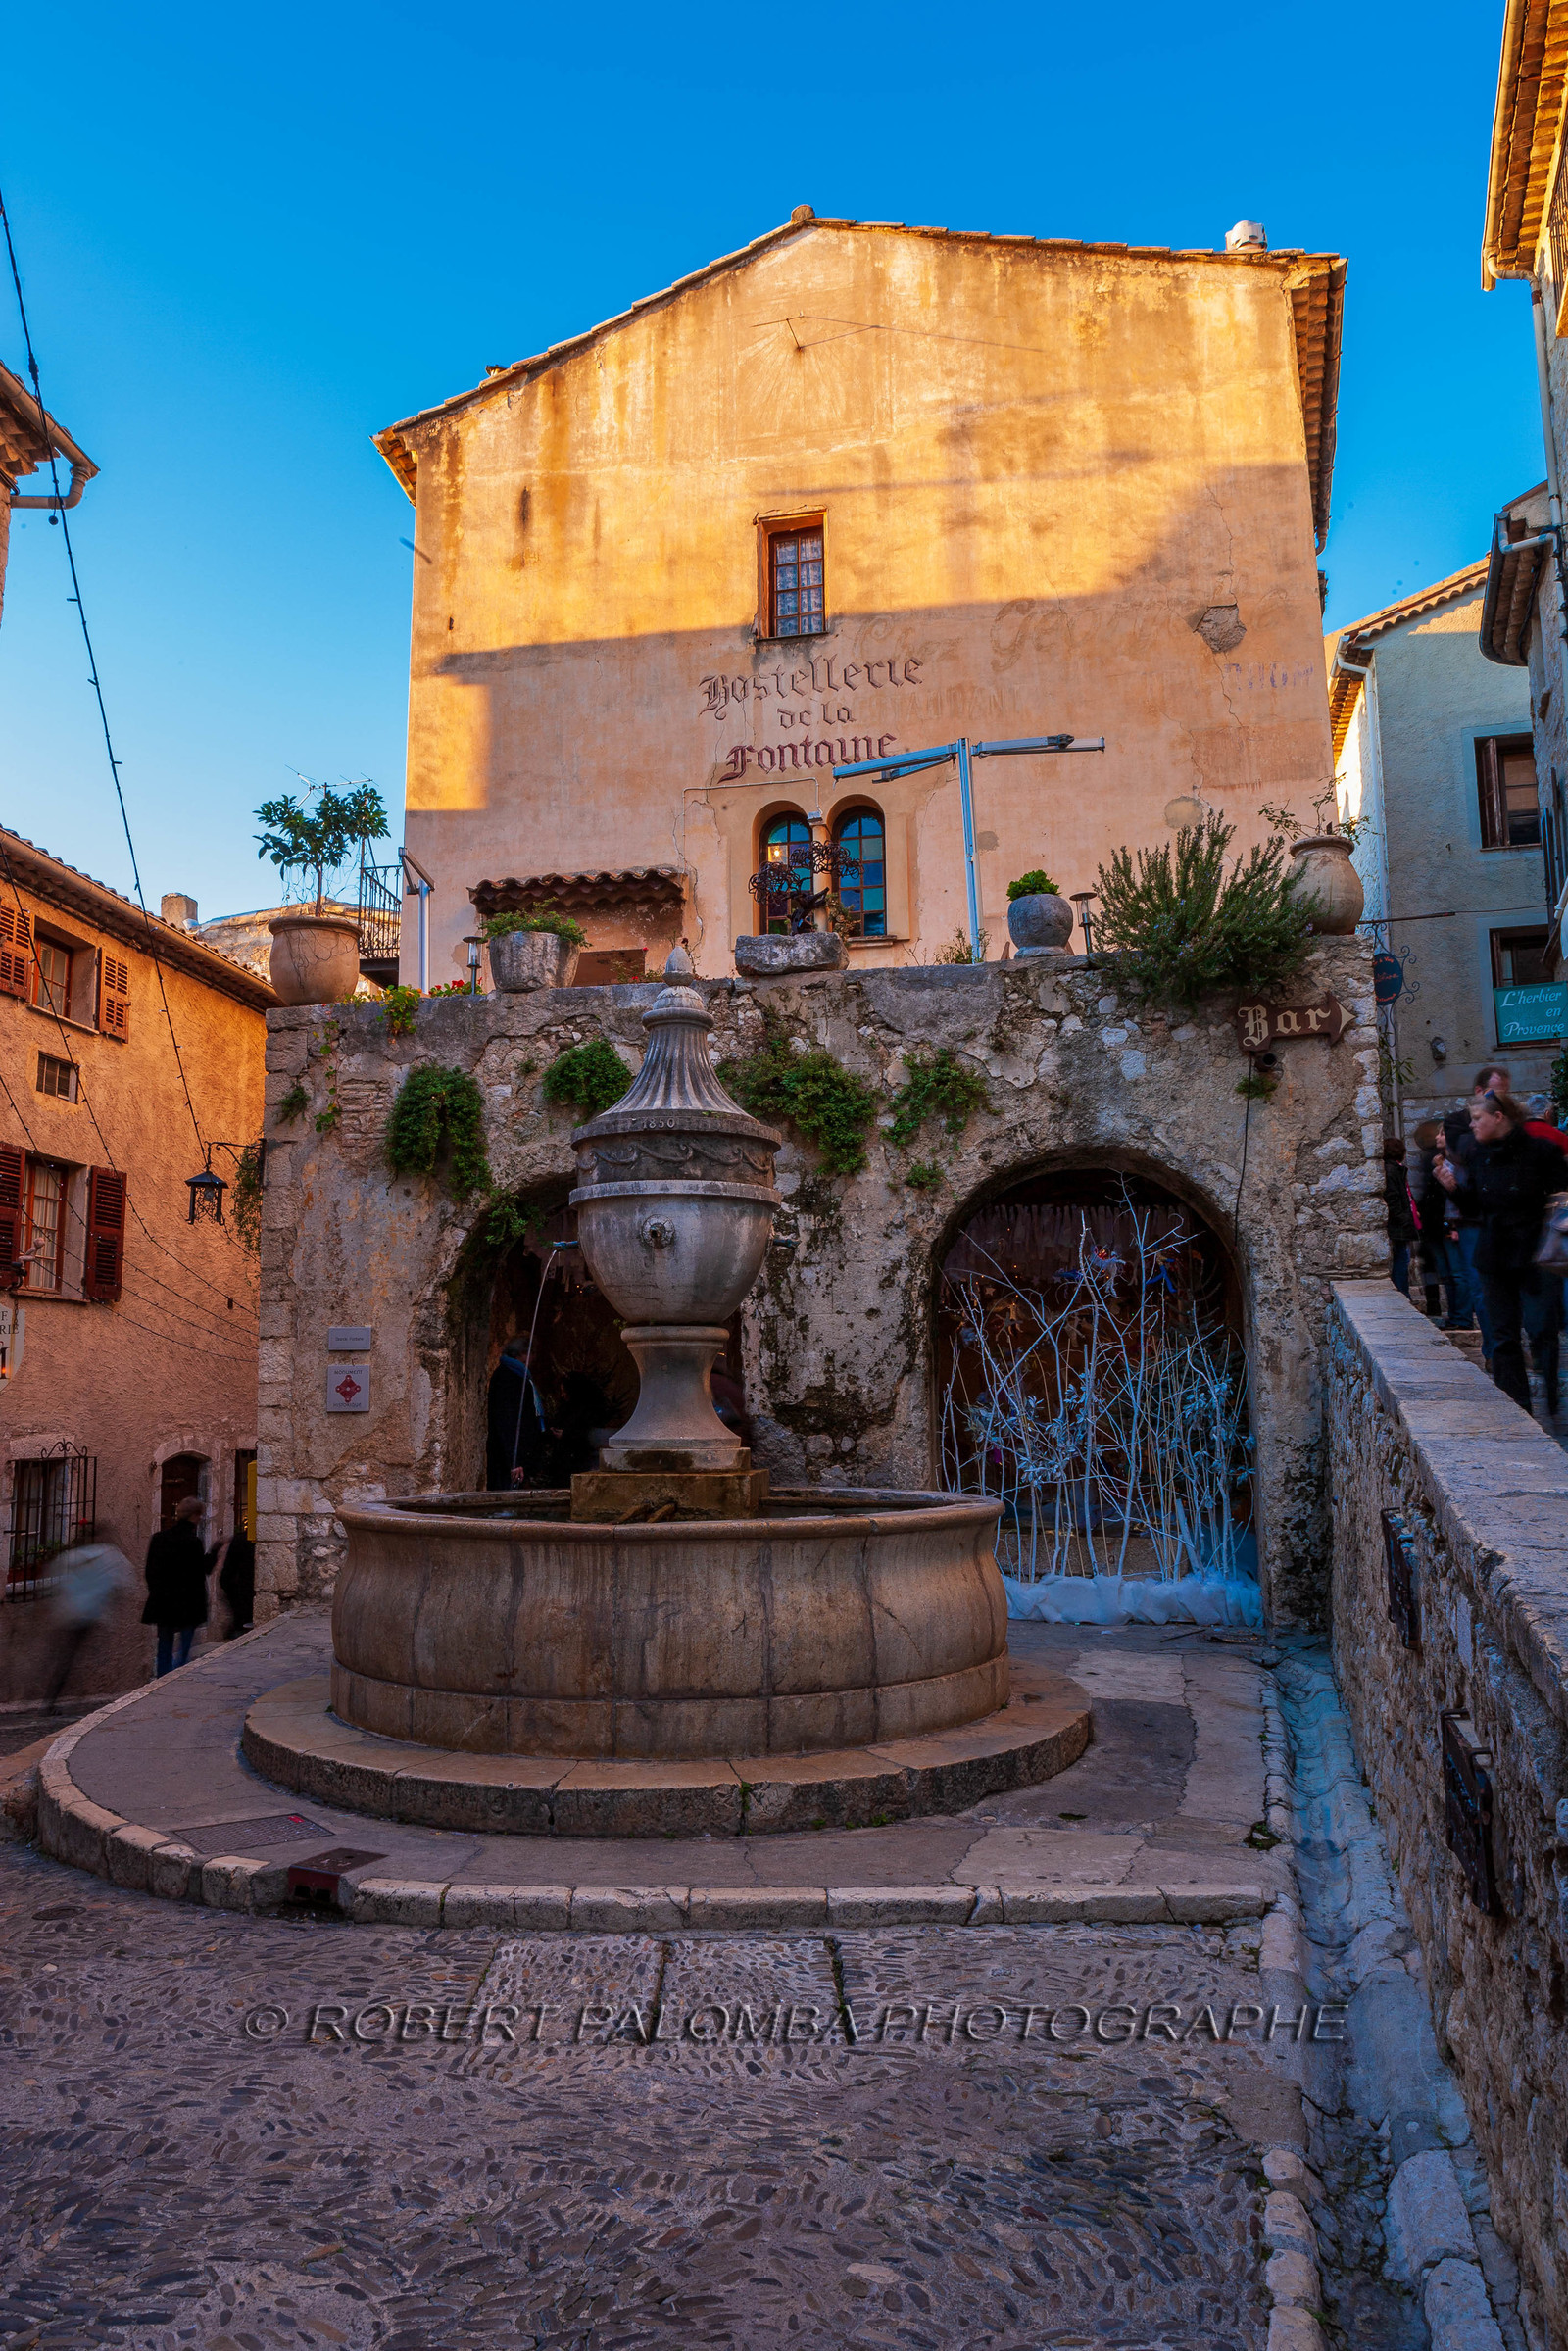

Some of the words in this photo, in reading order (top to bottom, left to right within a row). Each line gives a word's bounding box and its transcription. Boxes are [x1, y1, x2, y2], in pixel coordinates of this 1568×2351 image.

[699, 654, 923, 720] Hostellerie
[777, 708, 812, 729] de
[822, 703, 857, 725] la
[717, 733, 897, 784] Fontaine
[1500, 988, 1563, 1007] L'herbier
[1545, 1007, 1561, 1017] en
[1238, 1004, 1331, 1047] Bar
[1503, 1021, 1565, 1037] Provence
